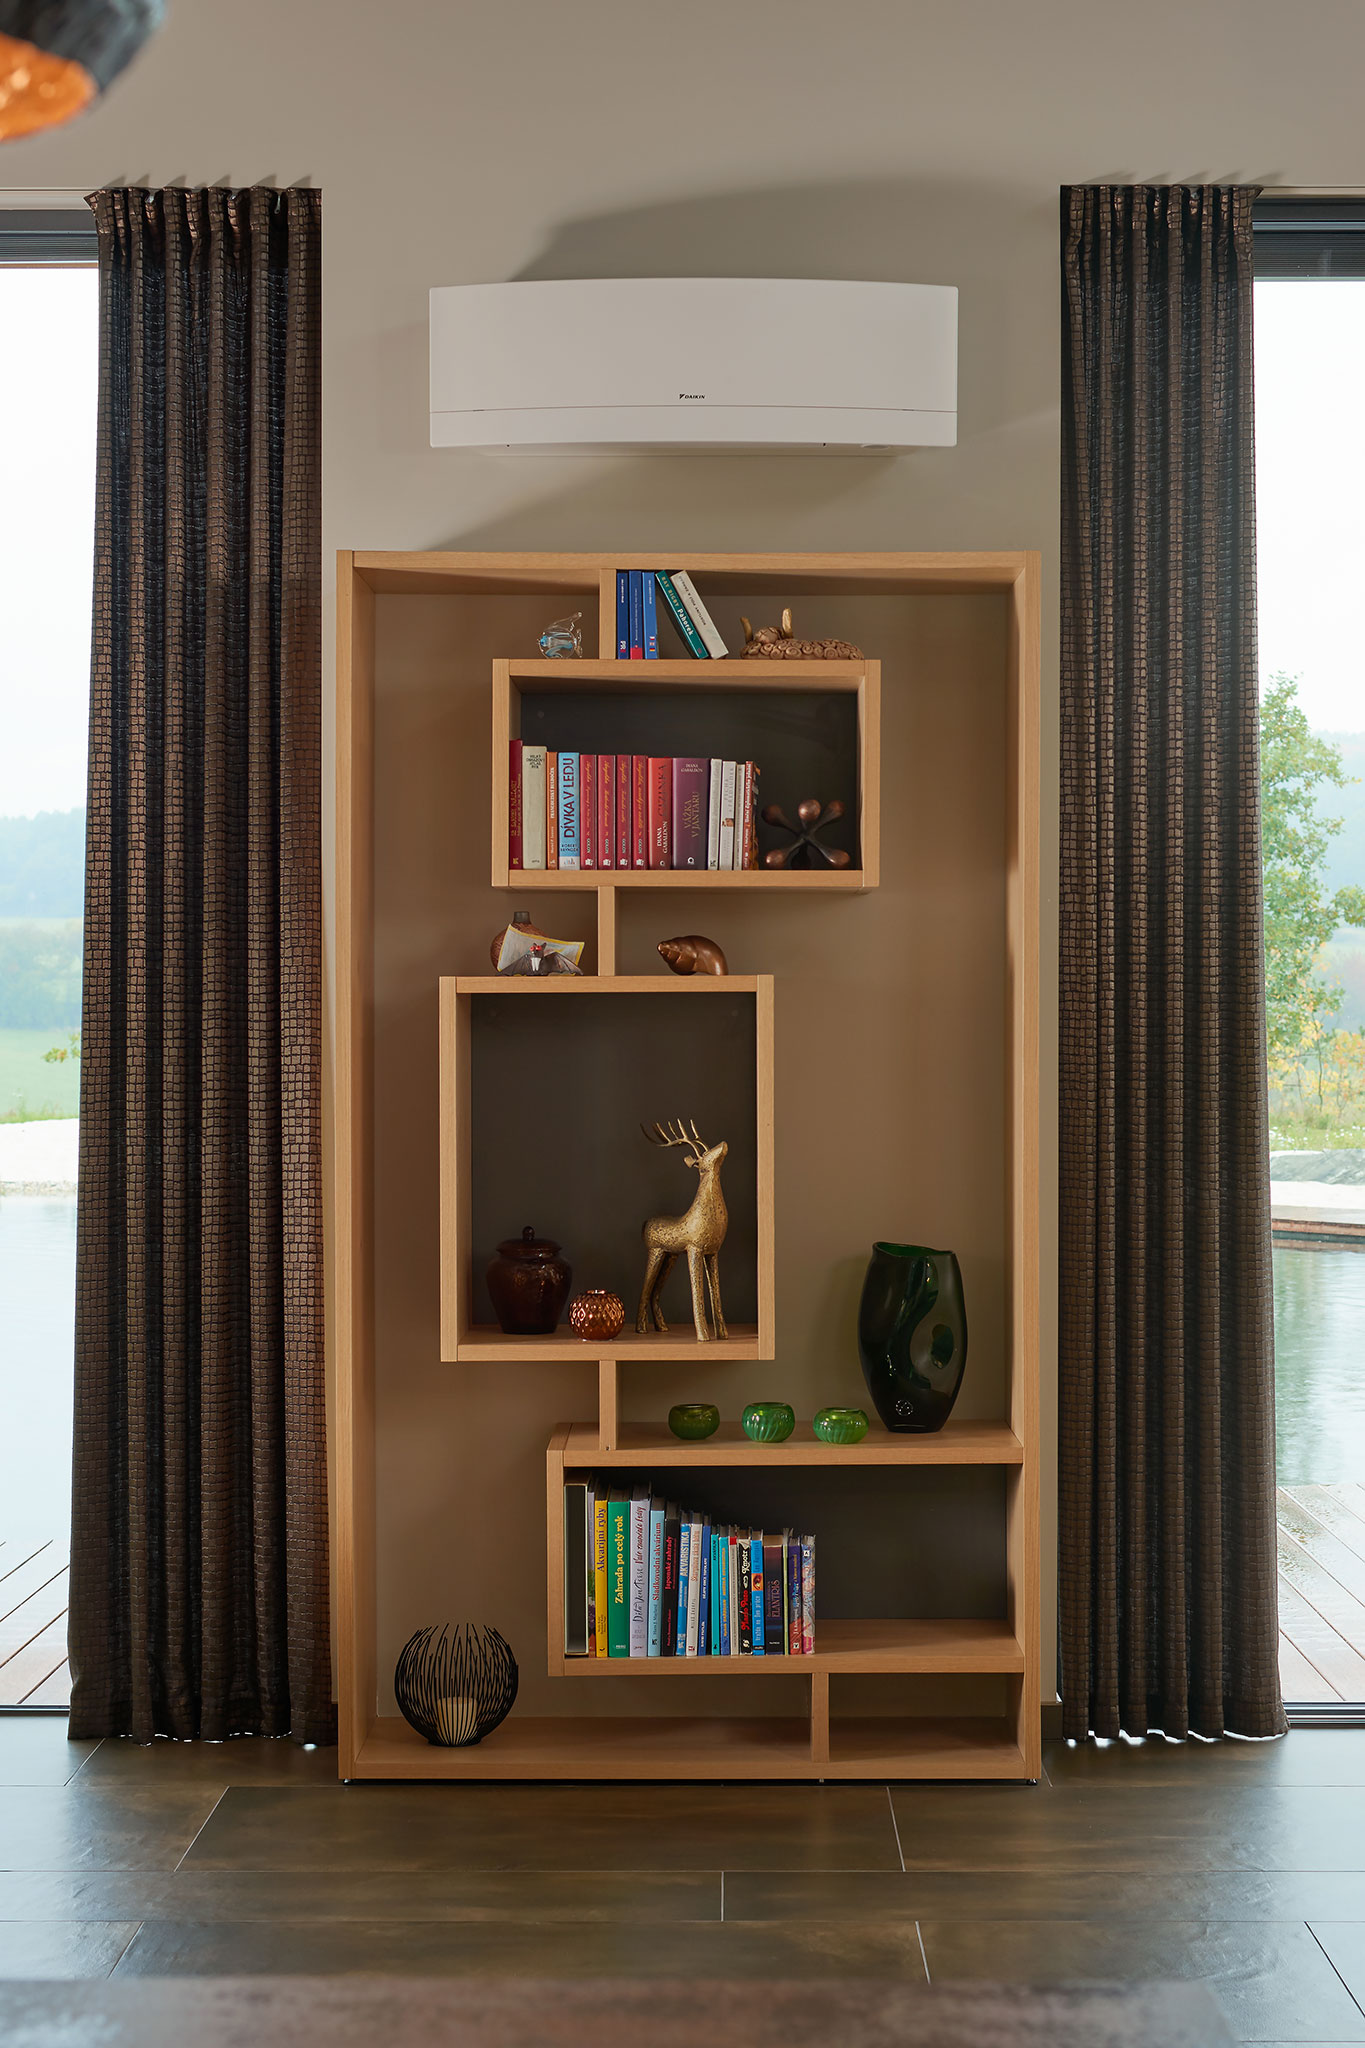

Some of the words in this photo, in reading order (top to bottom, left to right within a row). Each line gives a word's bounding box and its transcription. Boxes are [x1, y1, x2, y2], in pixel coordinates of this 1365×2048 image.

[677, 608, 694, 636] Pahorek
[563, 758, 575, 788] LEDU
[564, 791, 575, 802] V
[658, 764, 667, 817] CIZINKA
[561, 804, 575, 838] DÍVKA
[682, 800, 692, 829] VÁŽKA
[692, 792, 701, 830] JANTARU
[597, 1507, 607, 1523] ryby
[615, 1515, 623, 1533] rok
[597, 1526, 606, 1572] Akvarijní
[615, 1534, 625, 1552] celý
[653, 1522, 661, 1556] akvárium
[665, 1536, 673, 1560] zahrady
[616, 1553, 624, 1565] po
[680, 1531, 689, 1577] AKVARISTIKA
[742, 1550, 751, 1574] Kmotr
[615, 1567, 623, 1604] Zahrada
[652, 1558, 660, 1601] Sladkovodní
[740, 1590, 749, 1607] Puzo
[754, 1596, 762, 1608] práce
[772, 1579, 781, 1617] ELANTRIS
[740, 1608, 750, 1630] Mario
